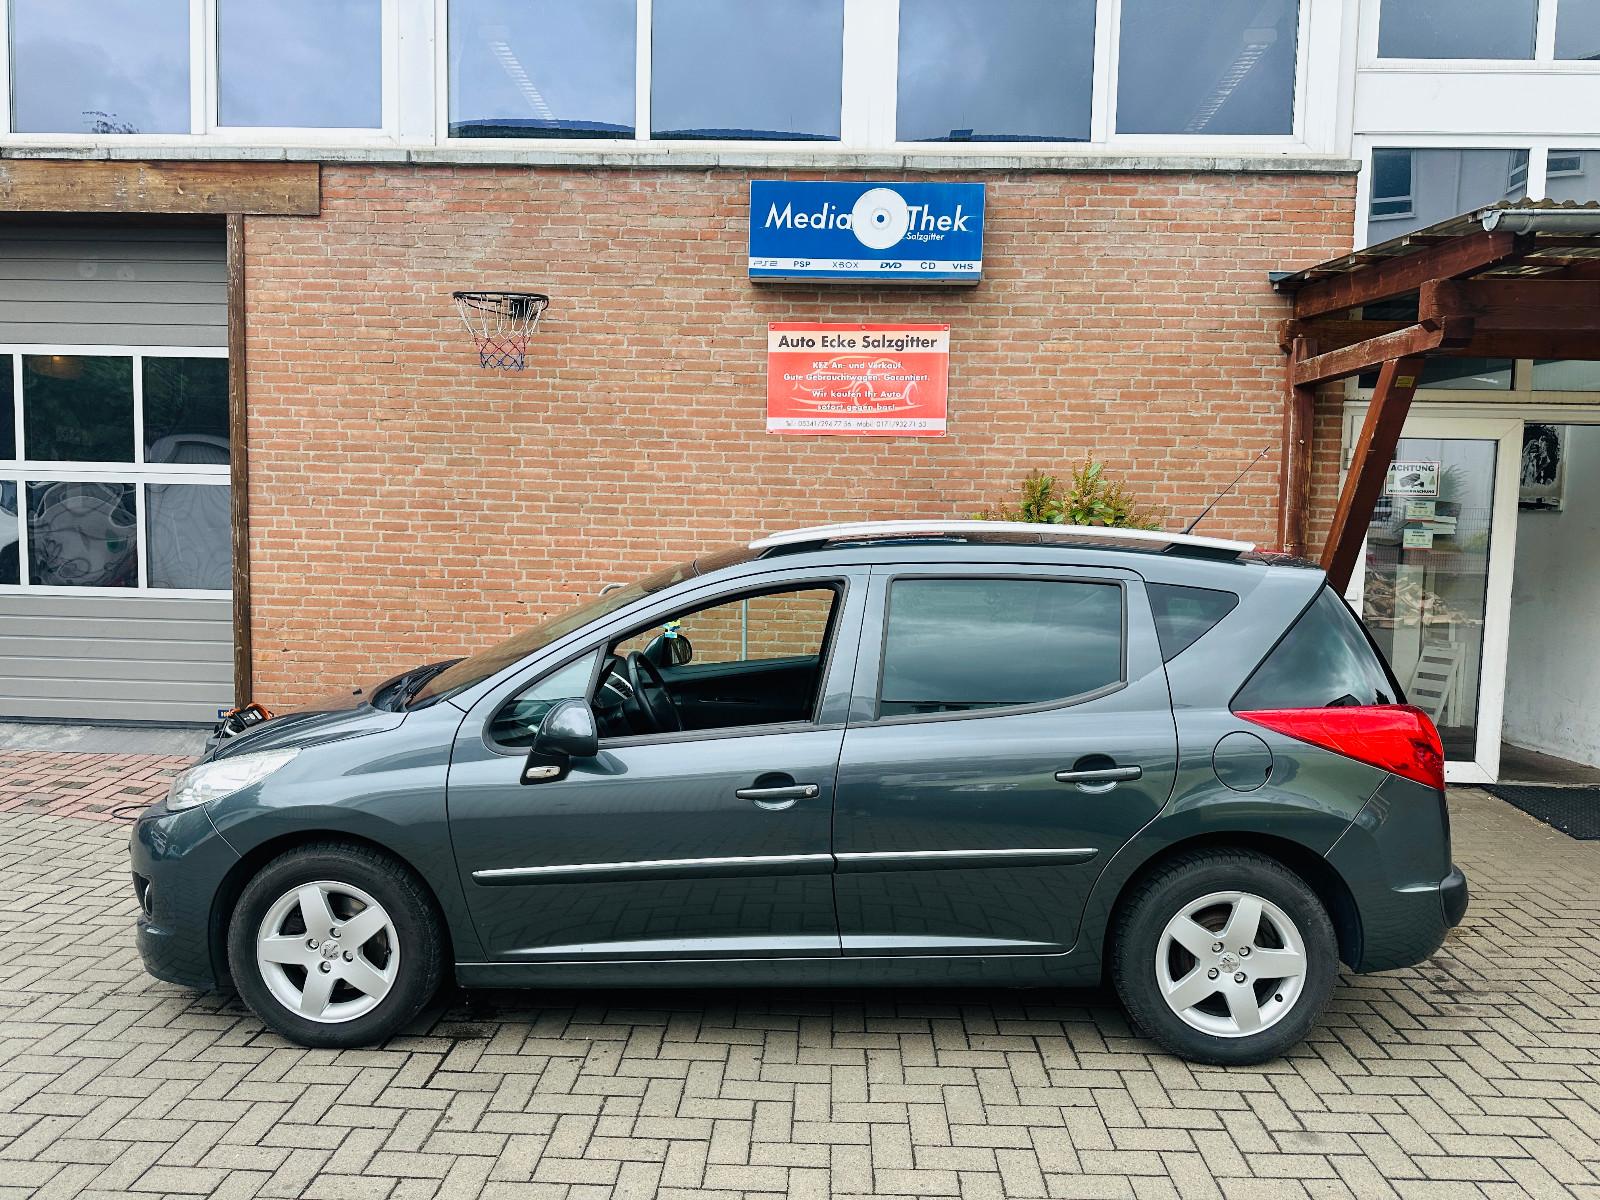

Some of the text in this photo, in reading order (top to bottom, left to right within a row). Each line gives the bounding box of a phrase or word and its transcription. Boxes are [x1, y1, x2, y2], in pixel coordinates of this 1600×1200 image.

[764, 201, 971, 232] Media Thek
[906, 232, 945, 243] Salzgitter
[793, 260, 811, 268] PSP
[832, 261, 859, 269] XBOX
[880, 261, 902, 269] DVD
[920, 261, 936, 270] CD
[778, 334, 938, 351] Auto Ecke Salzgitter
[812, 390, 828, 398] Wir
[831, 390, 862, 398] kaufen
[1390, 464, 1435, 472] ACHTUNG
